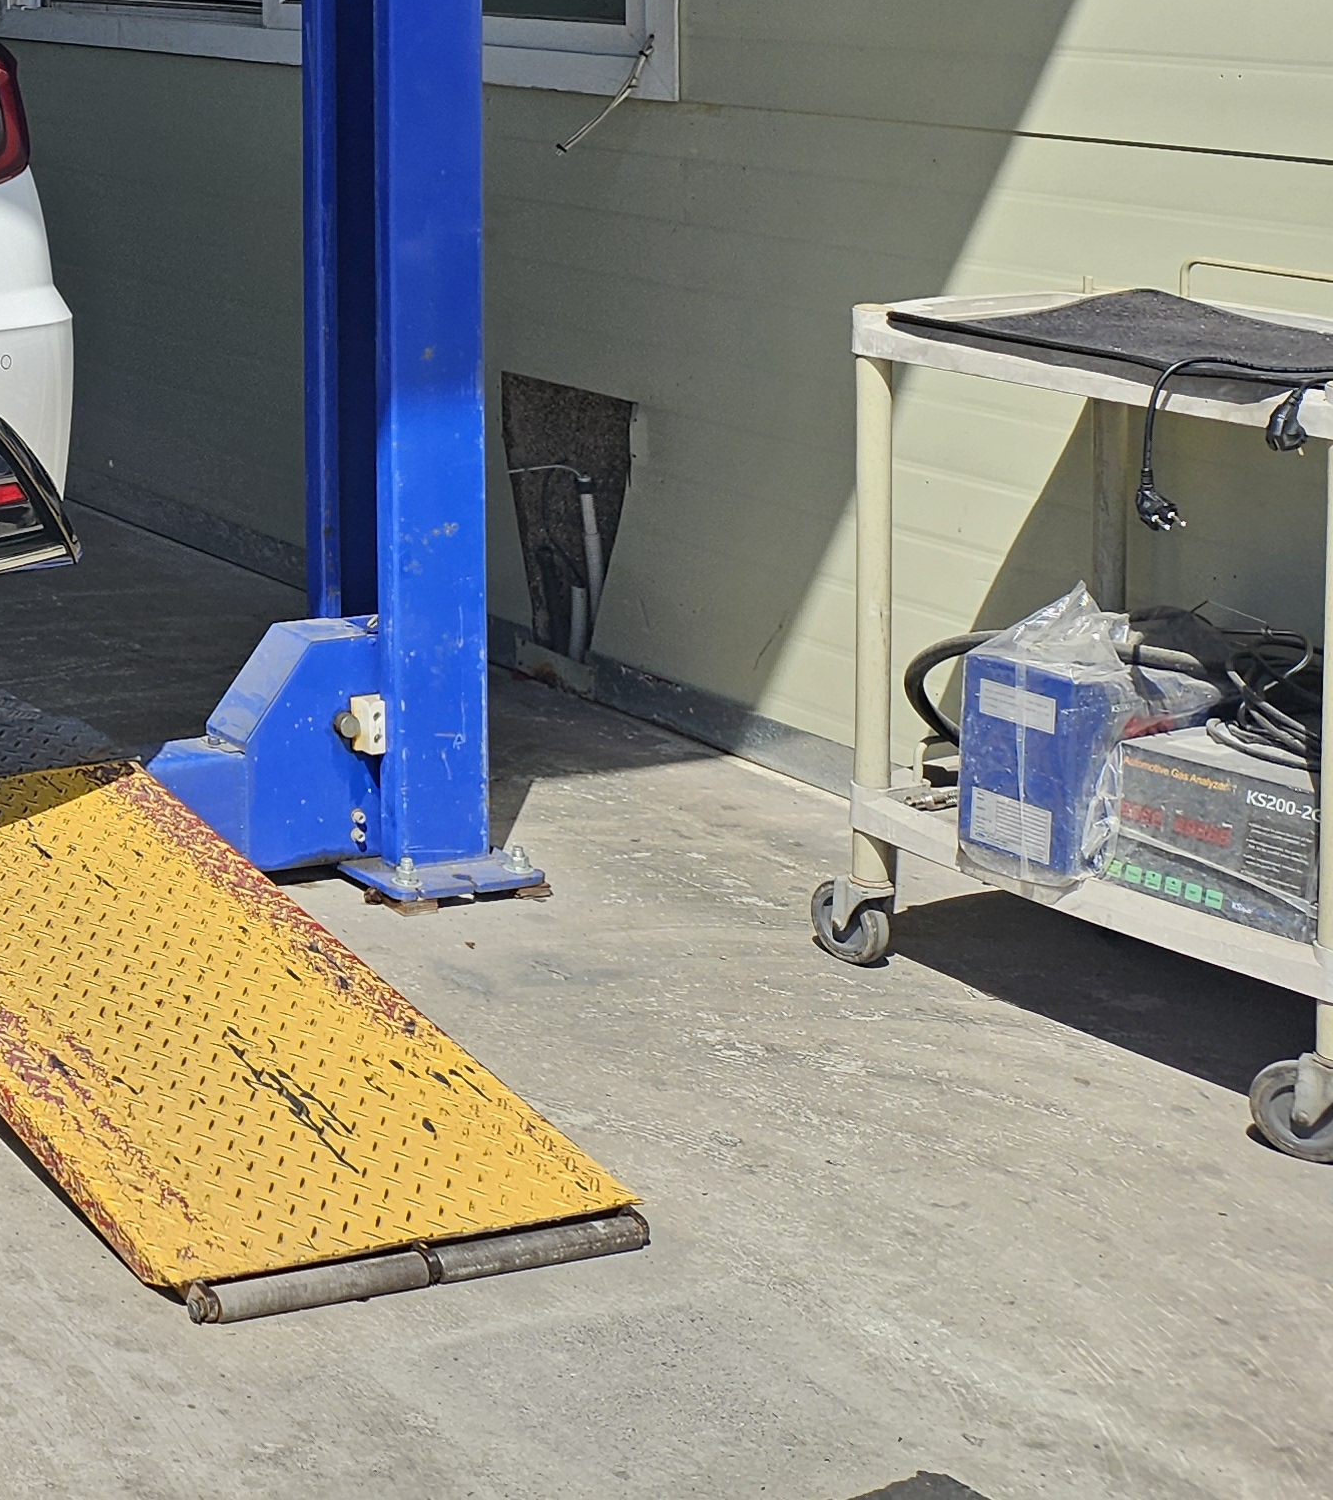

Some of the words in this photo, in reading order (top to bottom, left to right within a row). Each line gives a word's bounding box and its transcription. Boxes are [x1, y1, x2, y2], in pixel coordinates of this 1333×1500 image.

[1123, 755, 1171, 777] Automotive
[1171, 768, 1190, 781] Gas
[1189, 773, 1231, 792] Analyzer
